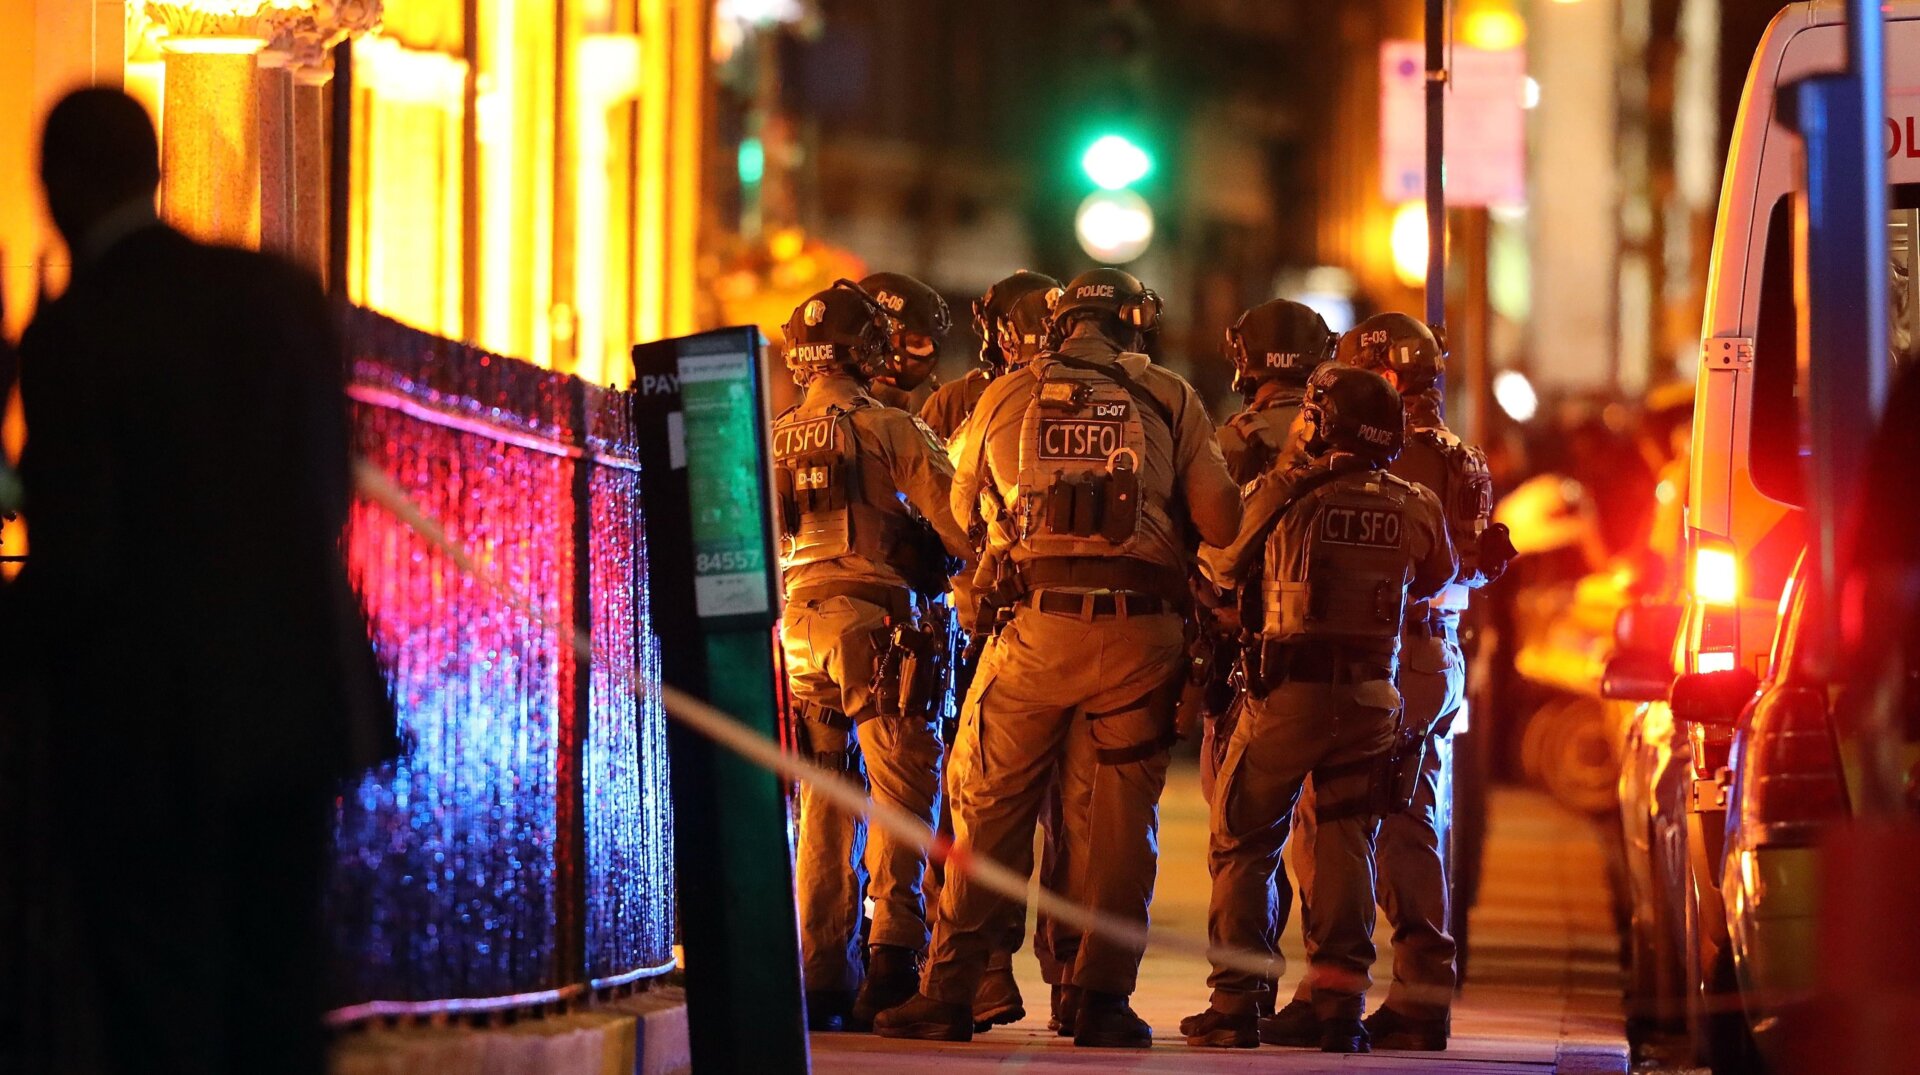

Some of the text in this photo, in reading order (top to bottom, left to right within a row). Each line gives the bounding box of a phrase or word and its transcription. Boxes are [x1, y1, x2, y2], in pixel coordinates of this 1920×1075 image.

[1076, 284, 1114, 299] POLICE
[1360, 330, 1387, 347] E-03
[798, 344, 834, 362] POLICE
[642, 373, 682, 396] PAY
[1097, 404, 1126, 417] D-07
[773, 419, 829, 457] CTSFO
[1045, 423, 1117, 456] CTSFO
[1358, 424, 1393, 446] POLICE
[798, 471, 824, 486] D-03
[695, 550, 760, 572] 84557
